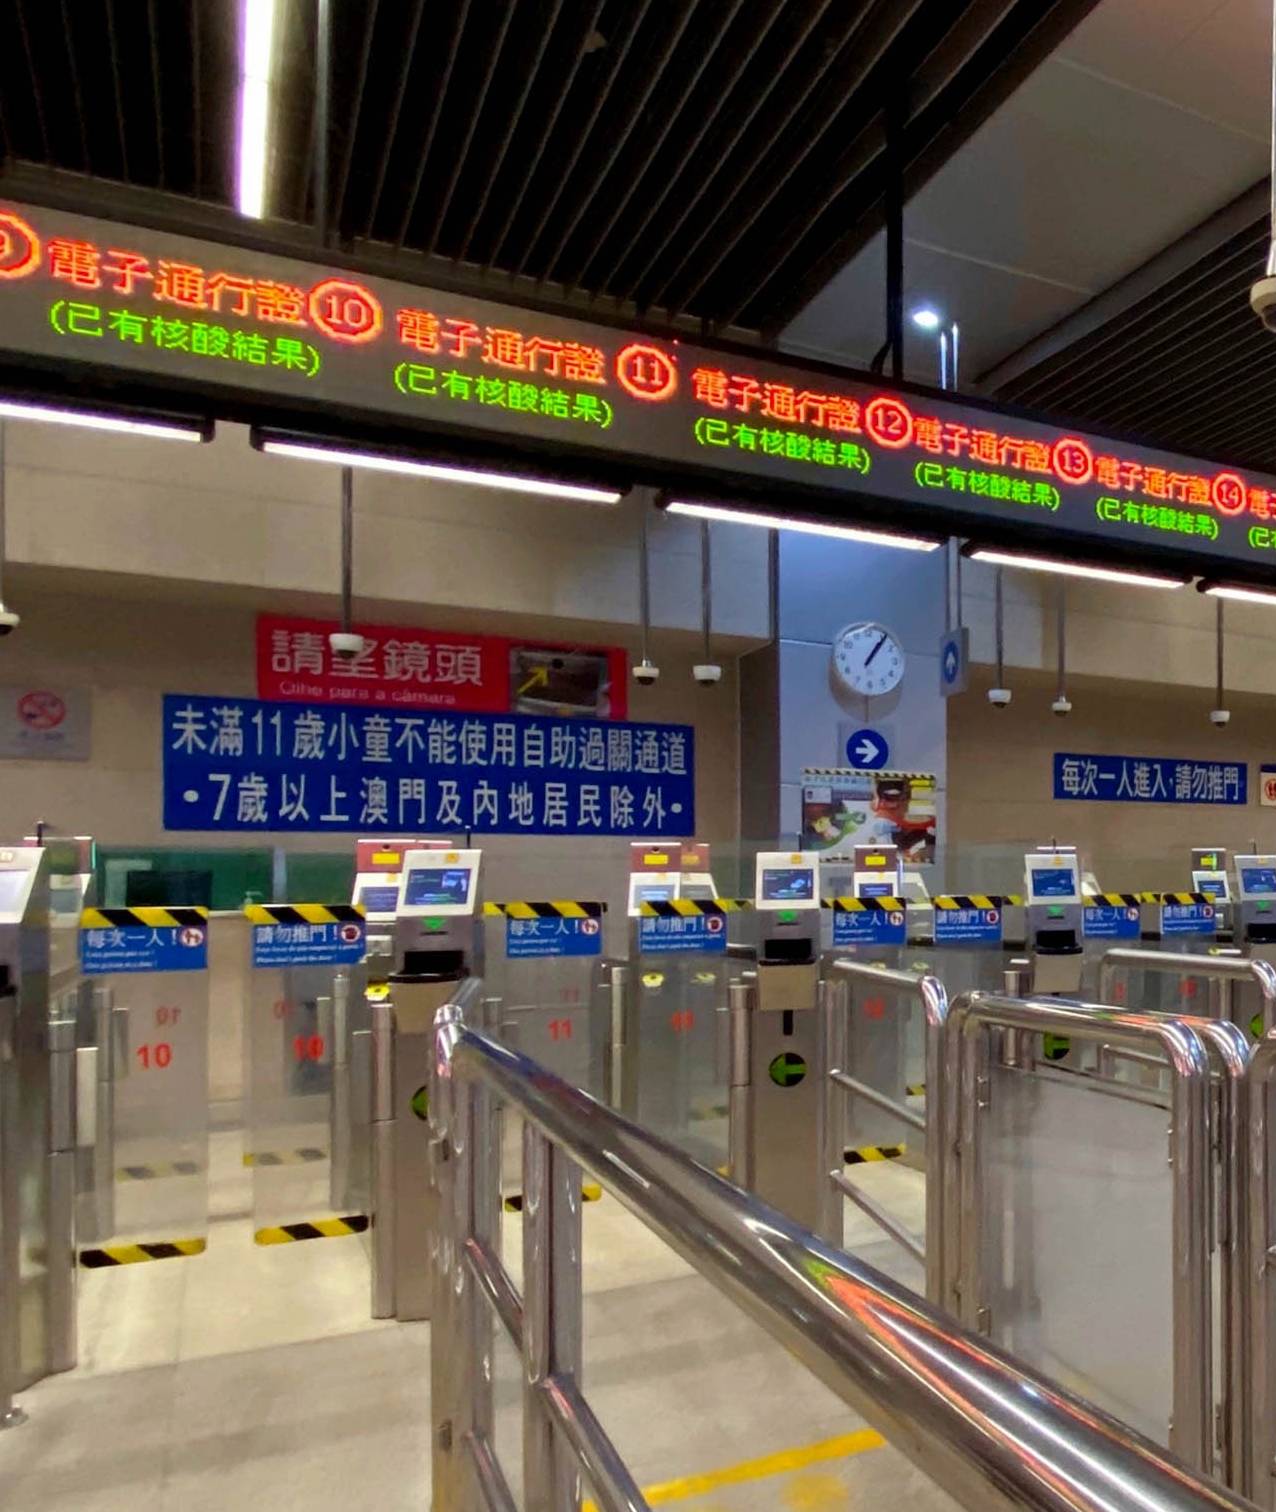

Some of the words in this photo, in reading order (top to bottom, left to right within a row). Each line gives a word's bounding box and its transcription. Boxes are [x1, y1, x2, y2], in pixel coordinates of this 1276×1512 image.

[48, 239, 307, 326] 電子通行證
[396, 308, 606, 385] 電子通行證
[692, 368, 862, 434] 電子通行證
[913, 417, 1052, 475] 電子通行證
[1096, 456, 1213, 507] 電子通行證
[375, 689, 386, 700] a
[172, 703, 687, 775] 未滿11歲小童不能使用自助過關通道
[137, 1043, 172, 1069] 10
